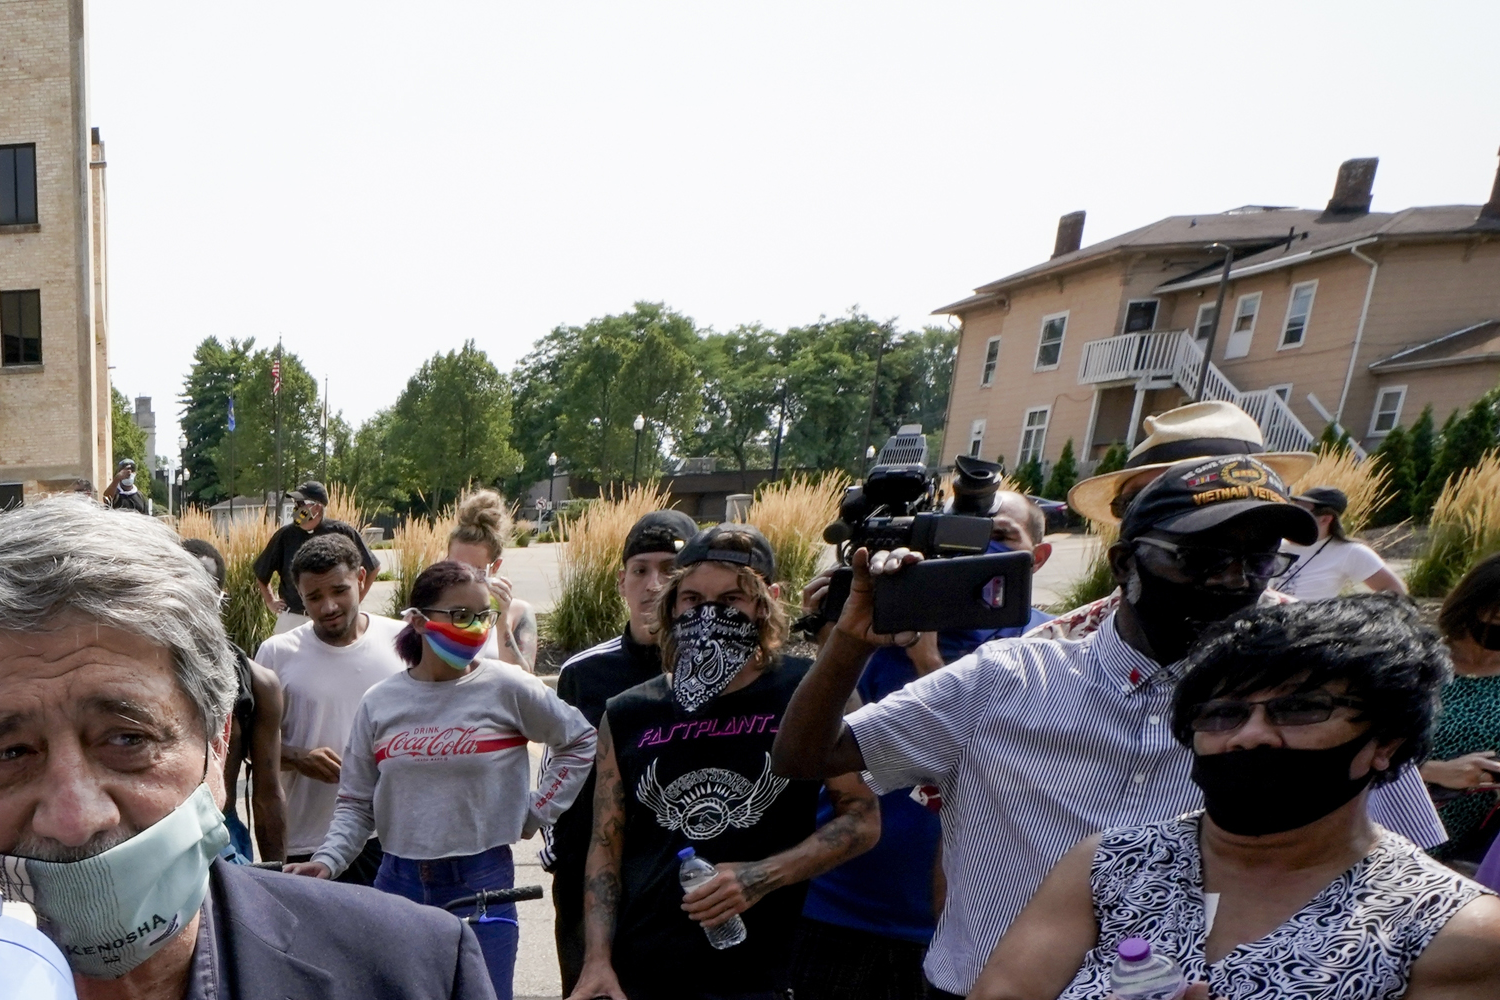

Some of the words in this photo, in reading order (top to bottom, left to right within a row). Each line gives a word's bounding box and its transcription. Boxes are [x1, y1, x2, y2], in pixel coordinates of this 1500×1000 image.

[1192, 485, 1249, 506] VIETNAM
[386, 726, 478, 759] Coca-Cola
[414, 726, 440, 735] DRINK
[638, 714, 779, 748] FASTPLANT
[65, 913, 167, 956] KENOSHA
